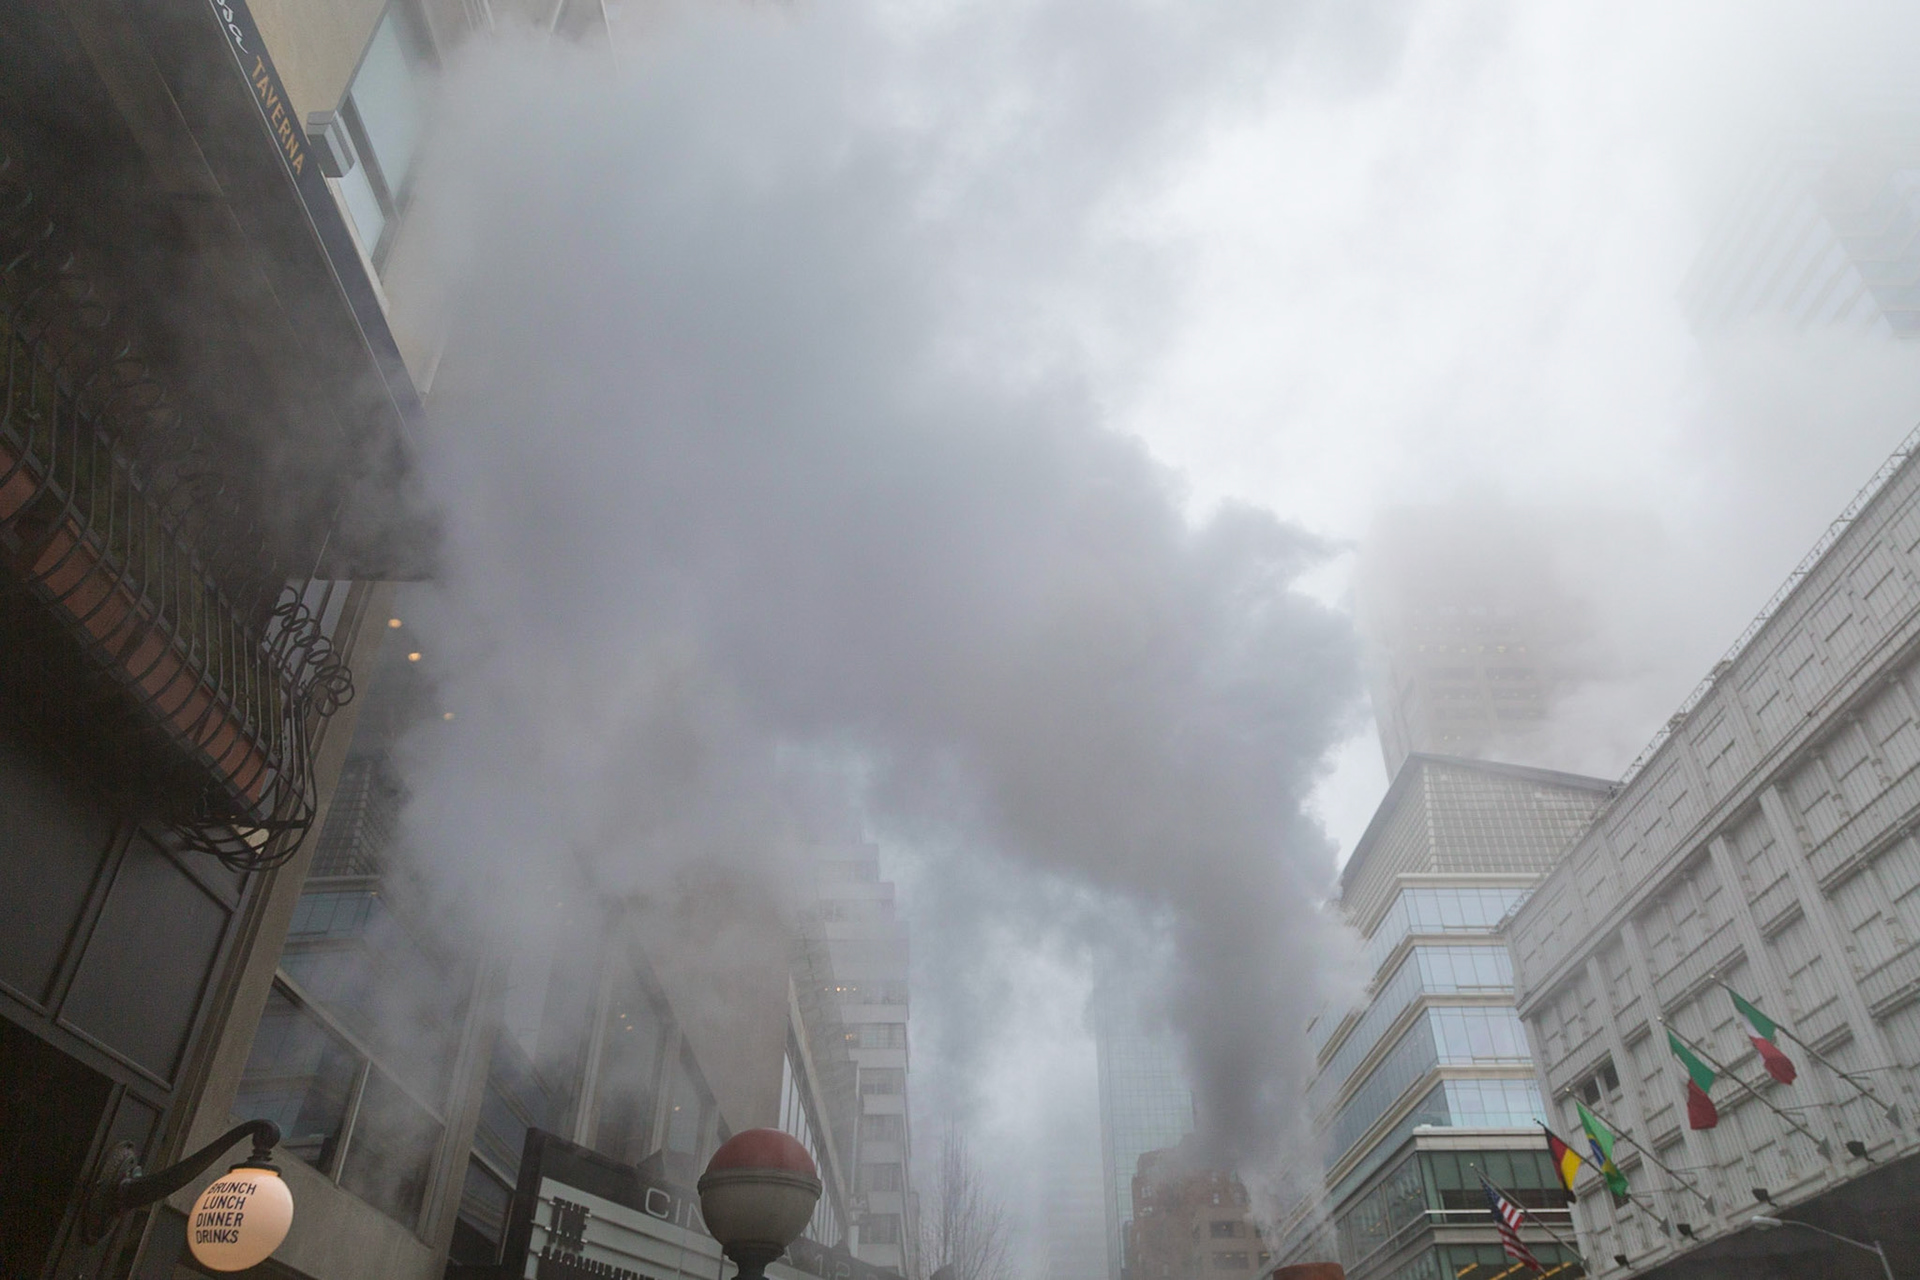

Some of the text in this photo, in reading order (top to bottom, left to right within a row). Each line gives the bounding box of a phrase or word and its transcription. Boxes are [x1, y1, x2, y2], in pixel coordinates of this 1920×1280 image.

[217, 0, 306, 175] sa TAVERNA
[207, 1181, 257, 1196] BRUNCH
[202, 1195, 247, 1210] LUNCH
[196, 1212, 244, 1227] DINNER
[196, 1229, 239, 1244] DRINKS
